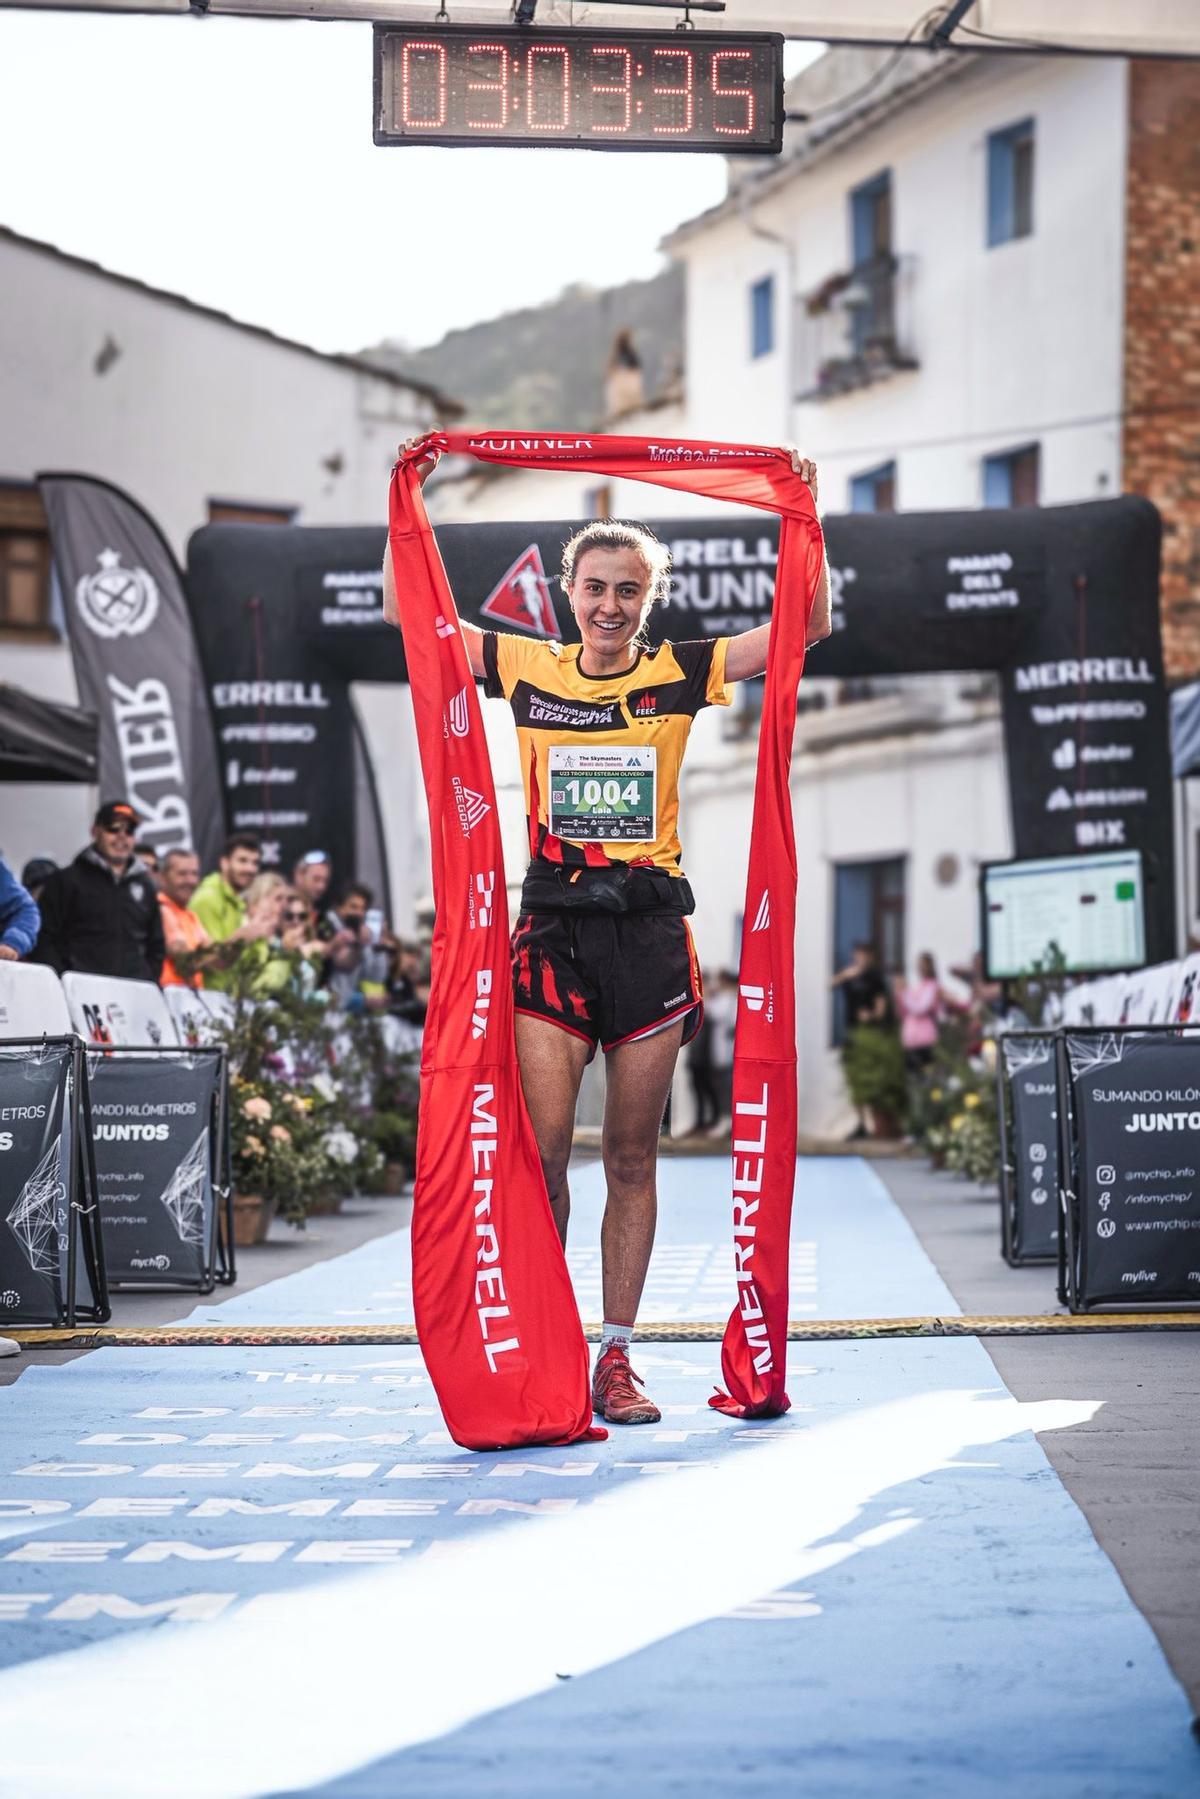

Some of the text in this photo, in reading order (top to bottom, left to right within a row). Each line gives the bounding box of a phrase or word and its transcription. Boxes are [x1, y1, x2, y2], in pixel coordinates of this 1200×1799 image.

[402, 42, 755, 135] 03:03:35
[667, 538, 778, 566] RELL
[213, 682, 328, 707] ERRELL
[635, 707, 656, 716] FEEC
[565, 780, 640, 805] 1004
[452, 776, 470, 839] GREGORY
[1092, 1086, 1200, 1102] SUMANDO KILÓ
[2, 1104, 46, 1120] ETROS
[91, 1102, 197, 1116] ANDO KILÓMETROS
[1125, 1111, 1200, 1133] JUNTO
[93, 1124, 170, 1141] JUNTOS
[1125, 1168, 1195, 1180] @mychip_info
[1125, 1192, 1192, 1205] /infomychip/
[470, 1083, 520, 1374] MERRELL
[731, 1082, 775, 1375] MERRELL
[1121, 1270, 1158, 1284] mylive
[247, 1371, 360, 1384] THE
[11, 1462, 725, 1478] DEMENT
[0, 1498, 580, 1517] DEMEN
